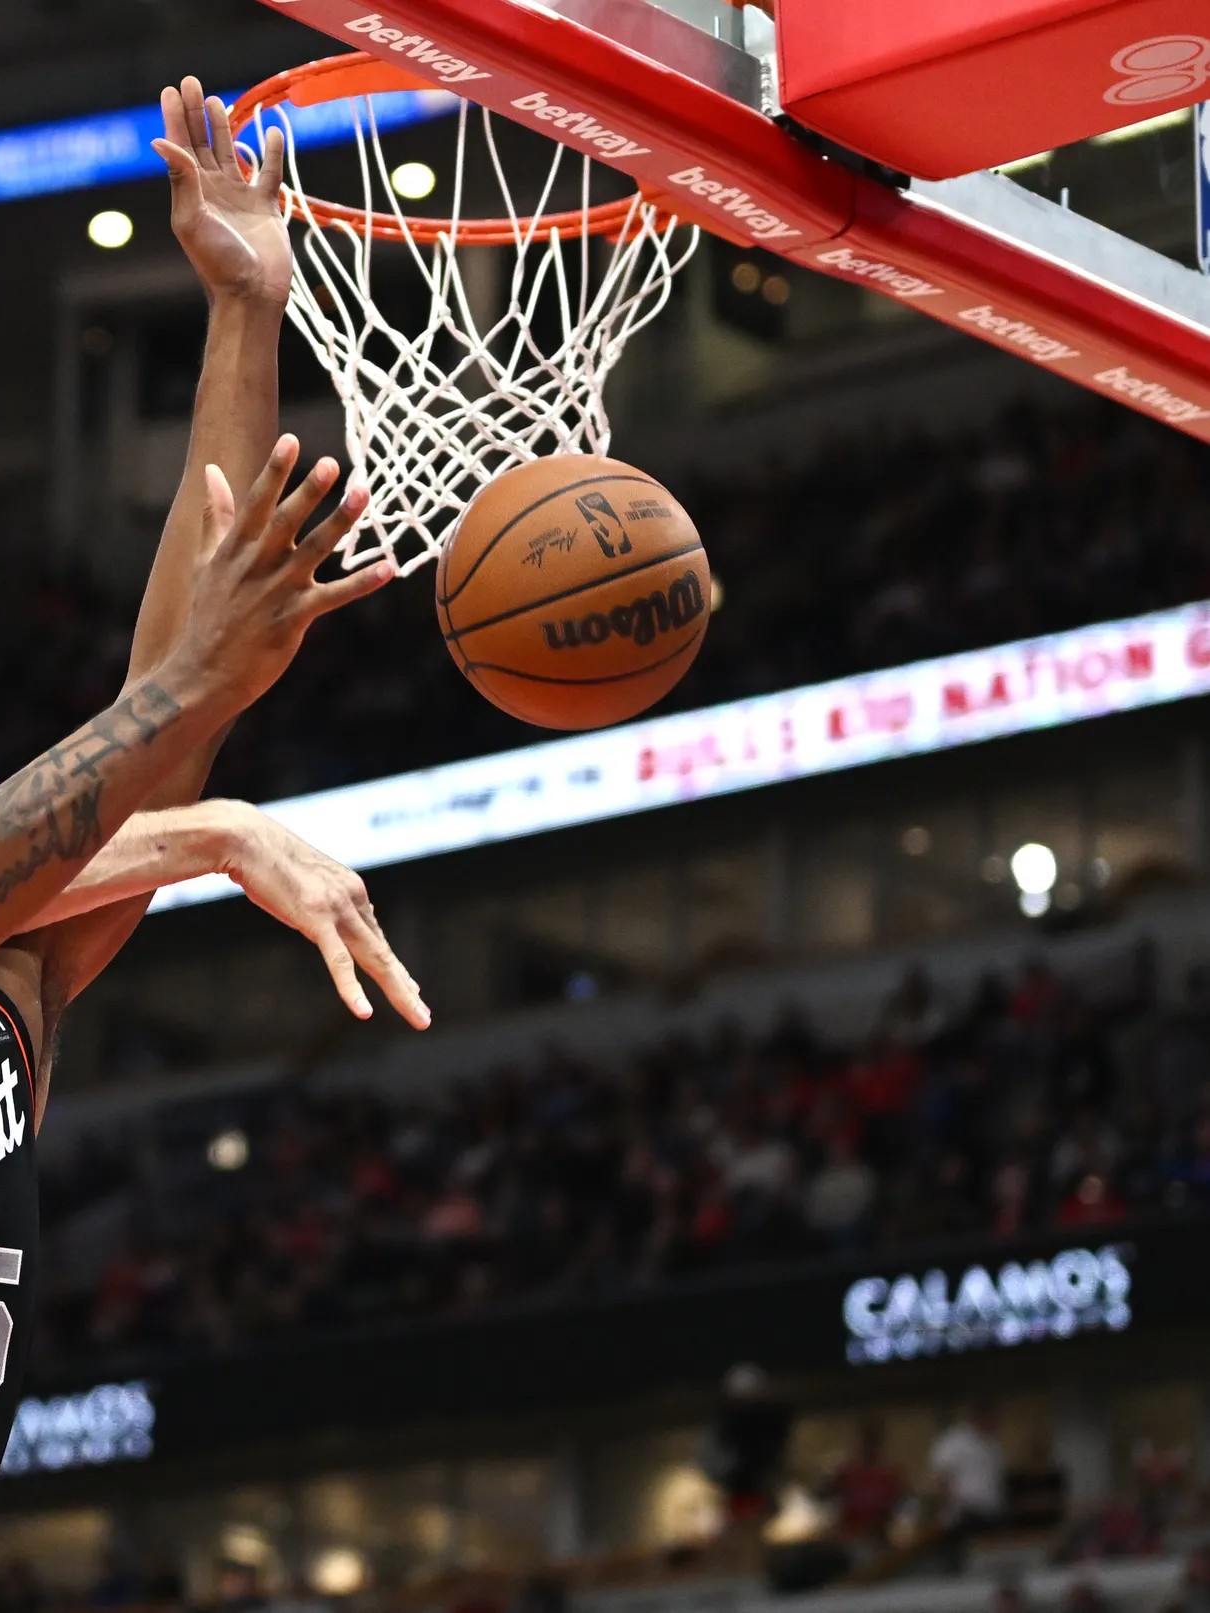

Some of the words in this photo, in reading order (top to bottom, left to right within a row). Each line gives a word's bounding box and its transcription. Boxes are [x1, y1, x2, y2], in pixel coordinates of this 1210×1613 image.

[343, 14, 492, 84] betway
[510, 91, 652, 159] betway
[667, 166, 802, 240] betway
[816, 247, 945, 299] betway
[957, 305, 1080, 361] betway
[1093, 366, 1210, 422] betway
[542, 570, 704, 649] Wilson
[842, 1244, 1132, 1339] CALAMOS
